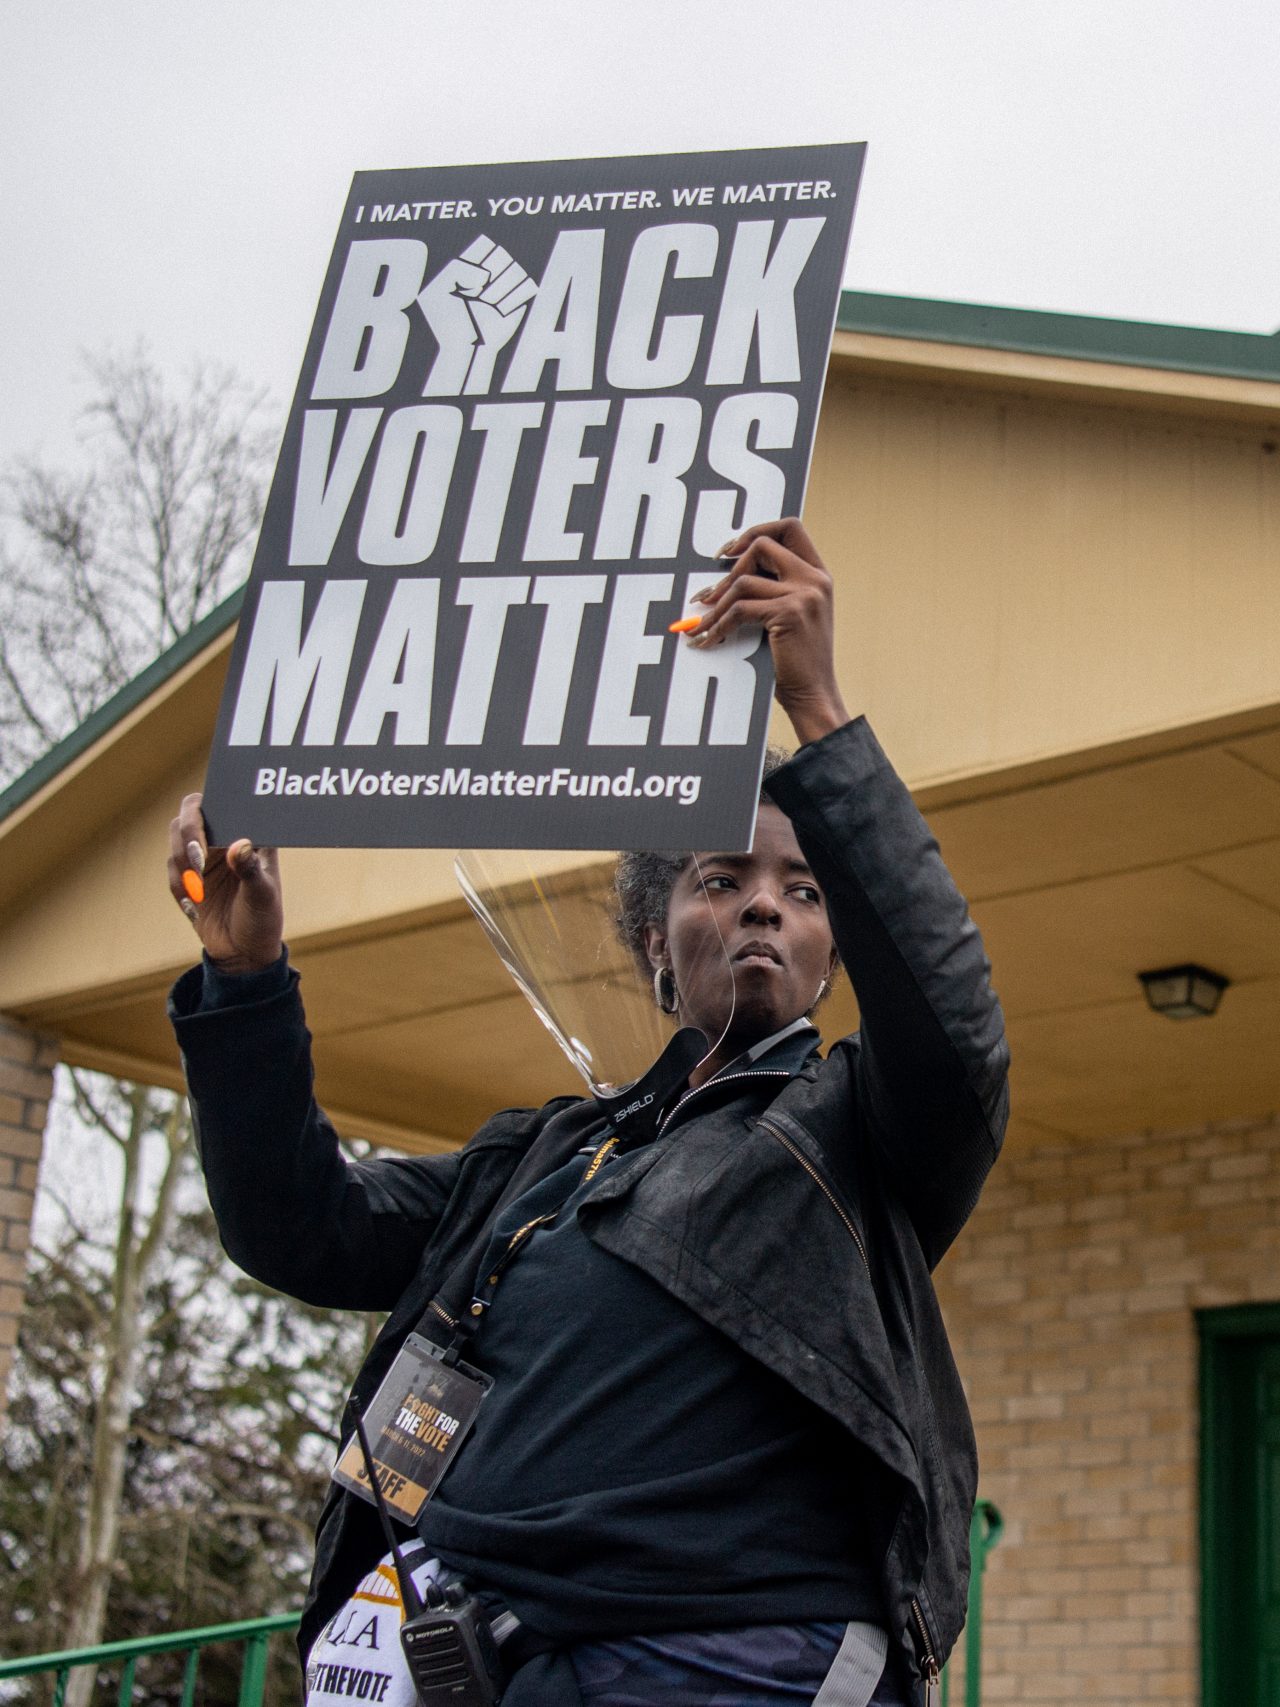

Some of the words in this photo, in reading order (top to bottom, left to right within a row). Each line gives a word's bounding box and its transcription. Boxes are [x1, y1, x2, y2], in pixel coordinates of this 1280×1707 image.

[354, 205, 365, 223] I
[370, 200, 477, 222] MATTER.
[488, 196, 544, 217] YOU
[551, 190, 662, 213] MATTER.
[672, 187, 715, 207] WE
[722, 180, 837, 204] MATTER.
[310, 216, 827, 400] BACK
[288, 392, 800, 567] VOTERS
[228, 571, 765, 746] MATTER
[254, 766, 702, 805] BlackVotersMatterFund.org
[357, 1459, 408, 1499] SAFF
